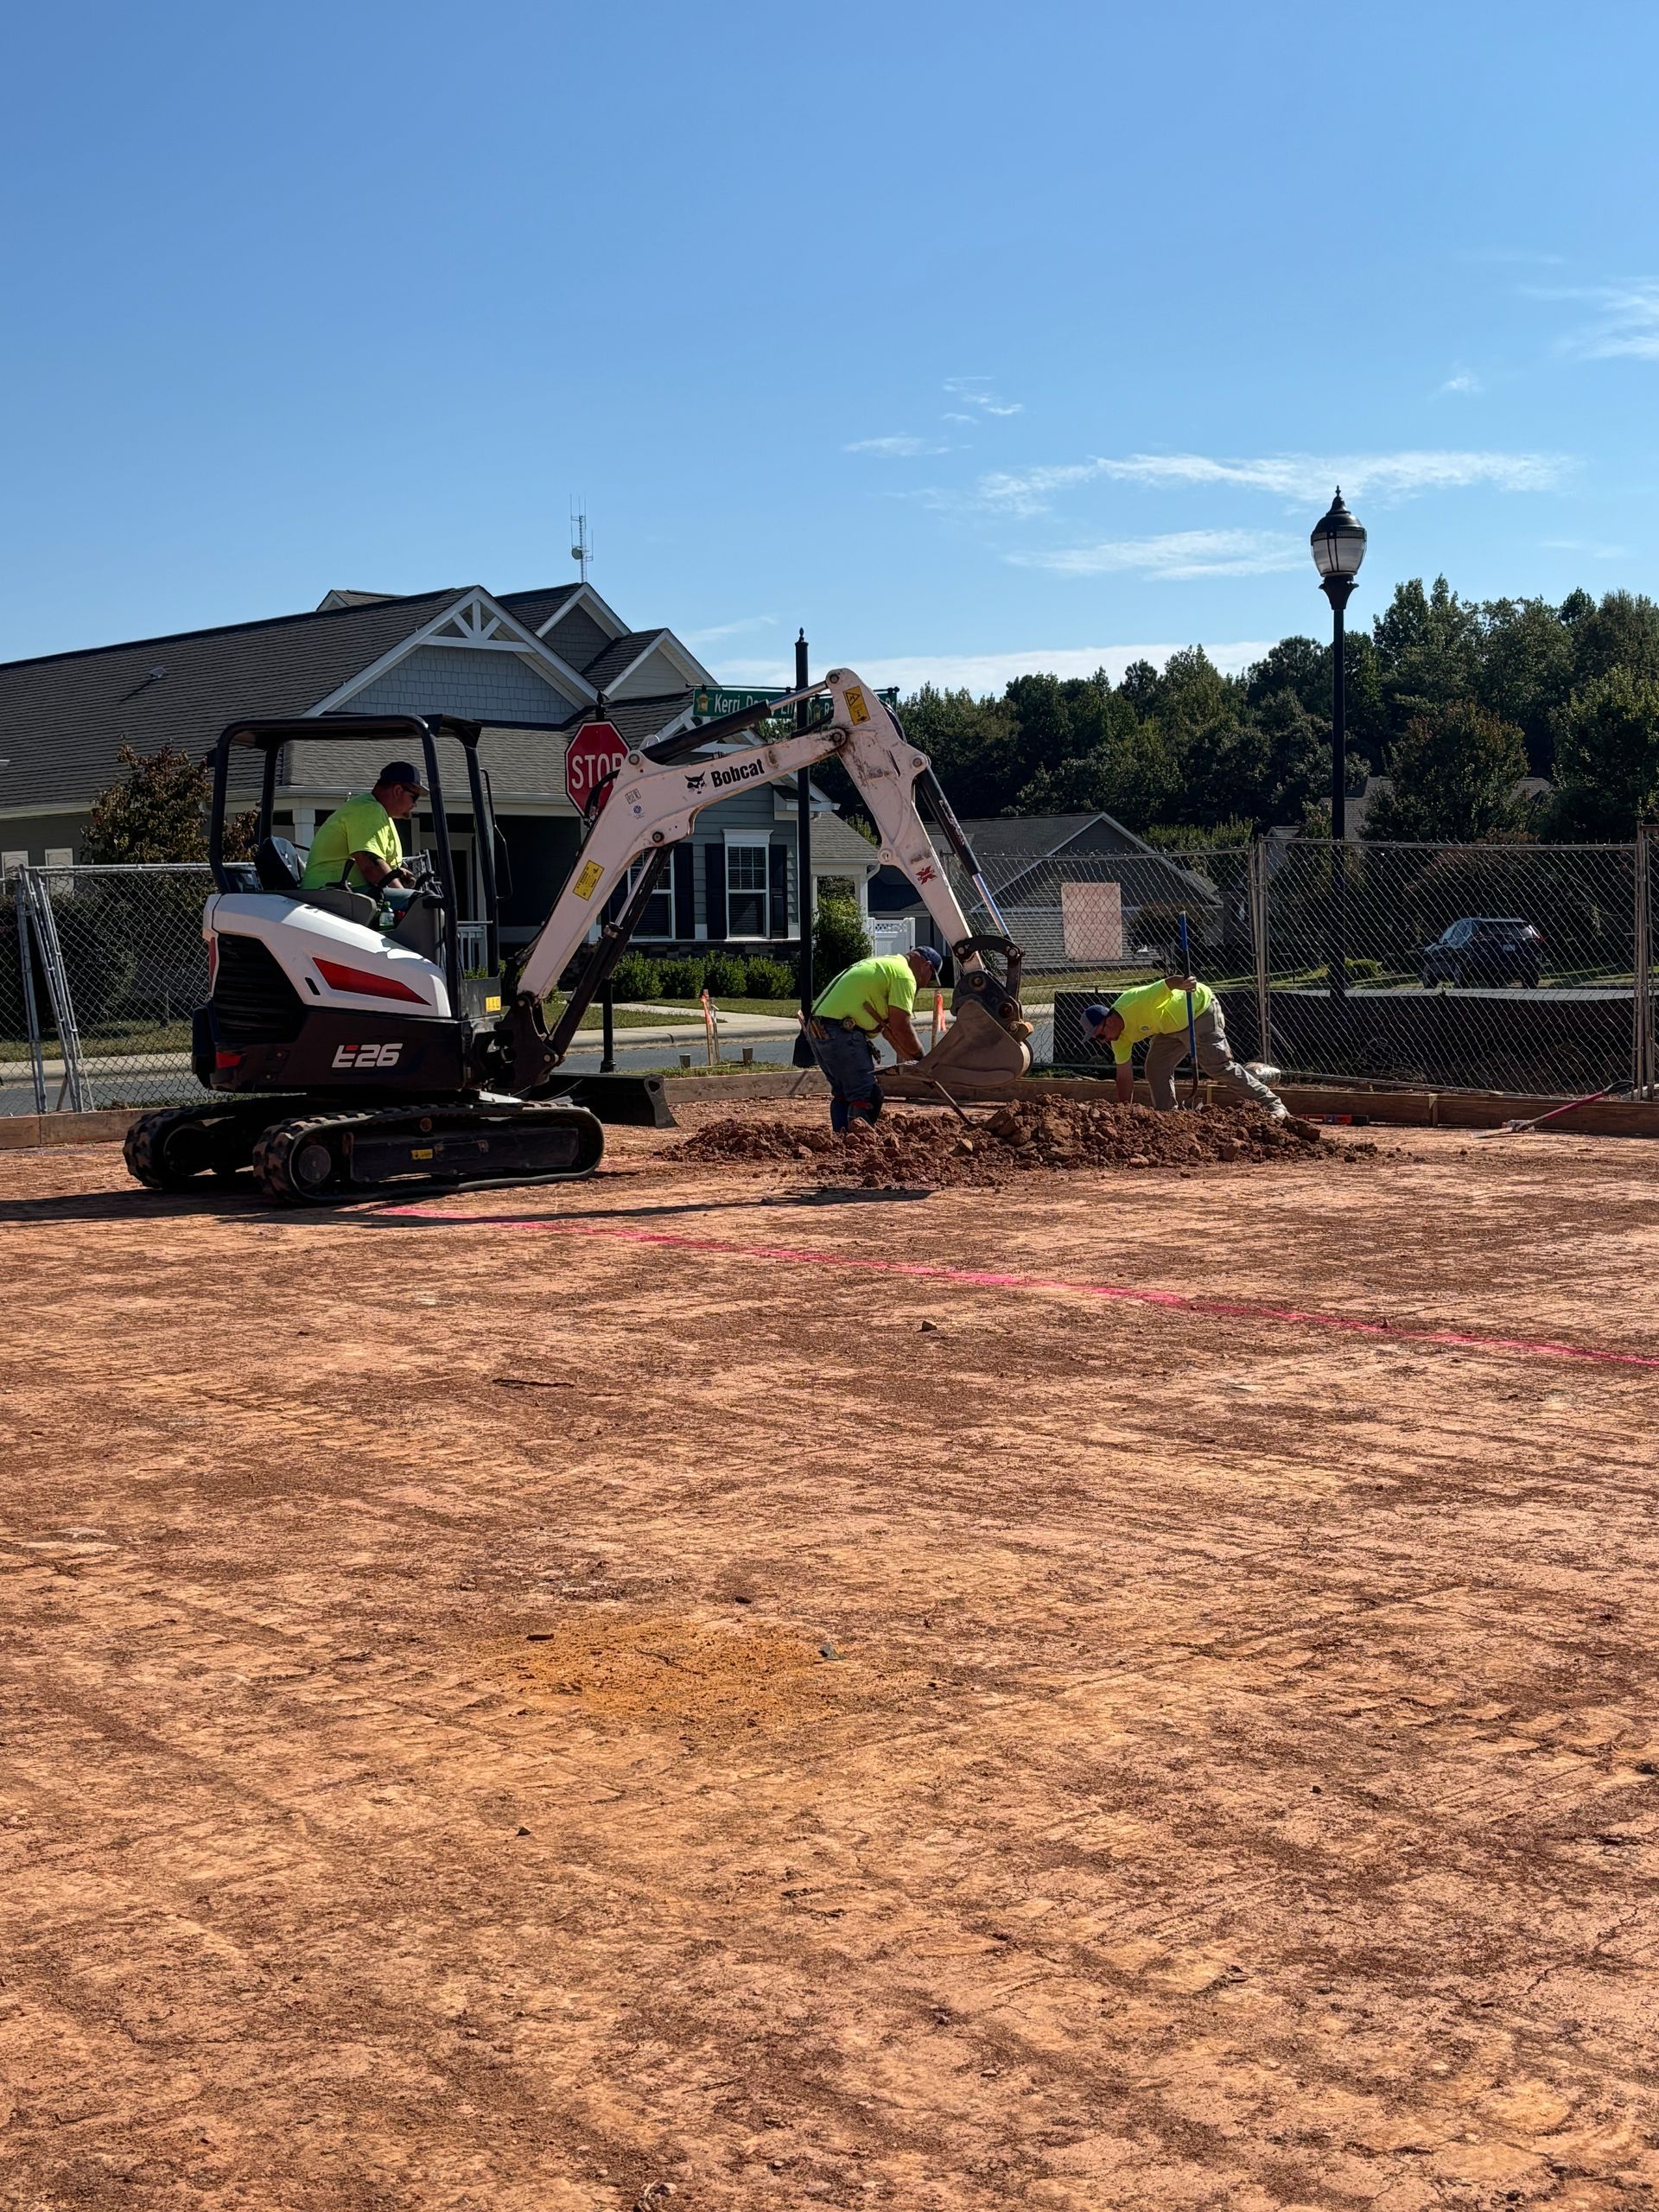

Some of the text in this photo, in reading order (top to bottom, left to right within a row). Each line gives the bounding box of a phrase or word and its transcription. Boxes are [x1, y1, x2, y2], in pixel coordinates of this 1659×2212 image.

[714, 694, 741, 714] Kerri
[571, 753, 625, 790] STOP
[710, 759, 766, 788] Bobcat
[331, 1043, 404, 1068] E26
